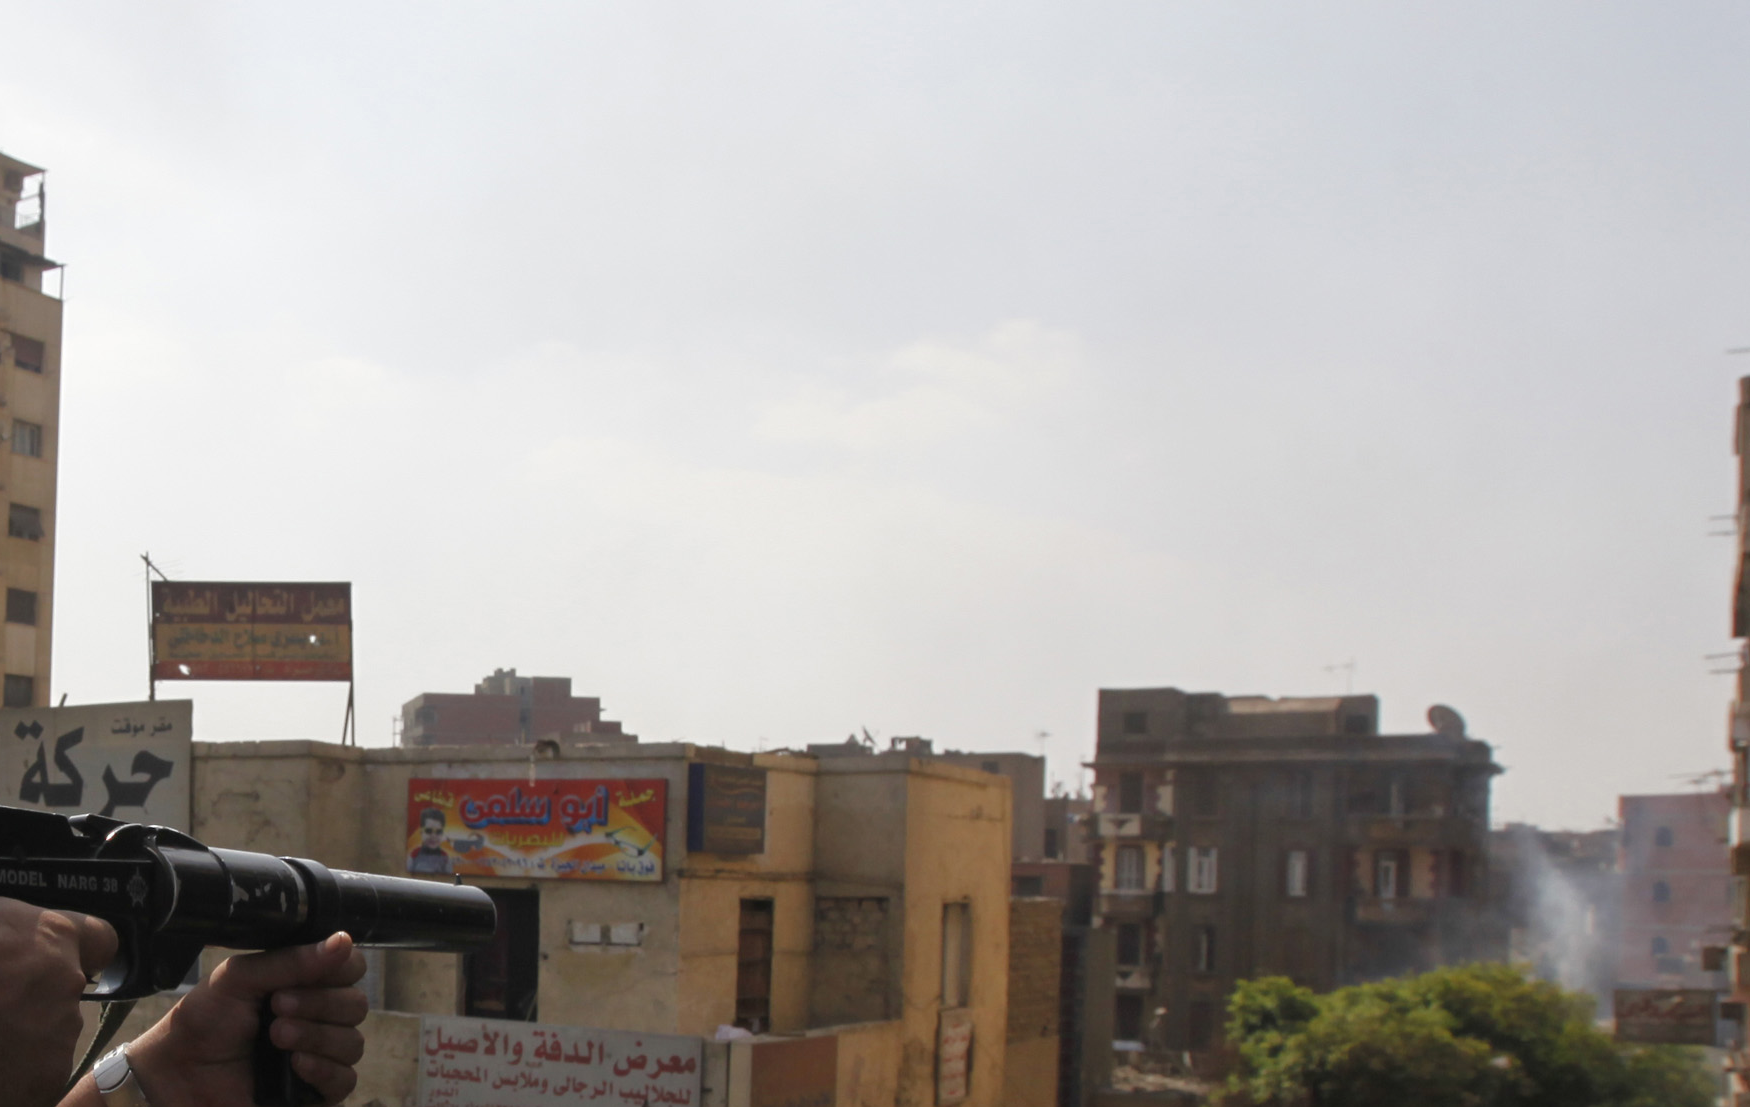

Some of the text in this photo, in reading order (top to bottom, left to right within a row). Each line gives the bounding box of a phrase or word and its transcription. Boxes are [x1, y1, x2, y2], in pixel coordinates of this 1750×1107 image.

[161, 588, 345, 623] معمل التحاليل الطبية
[14, 720, 174, 817] حركة
[459, 786, 552, 830] سلمى
[615, 788, 656, 807] جملة
[57, 873, 98, 892] NARG
[533, 1030, 604, 1065] الدفة
[612, 1040, 696, 1080] معرض
[425, 1058, 488, 1085] المحجبات
[491, 1070, 549, 1094] وملابس
[553, 1075, 614, 1100] الرجالى
